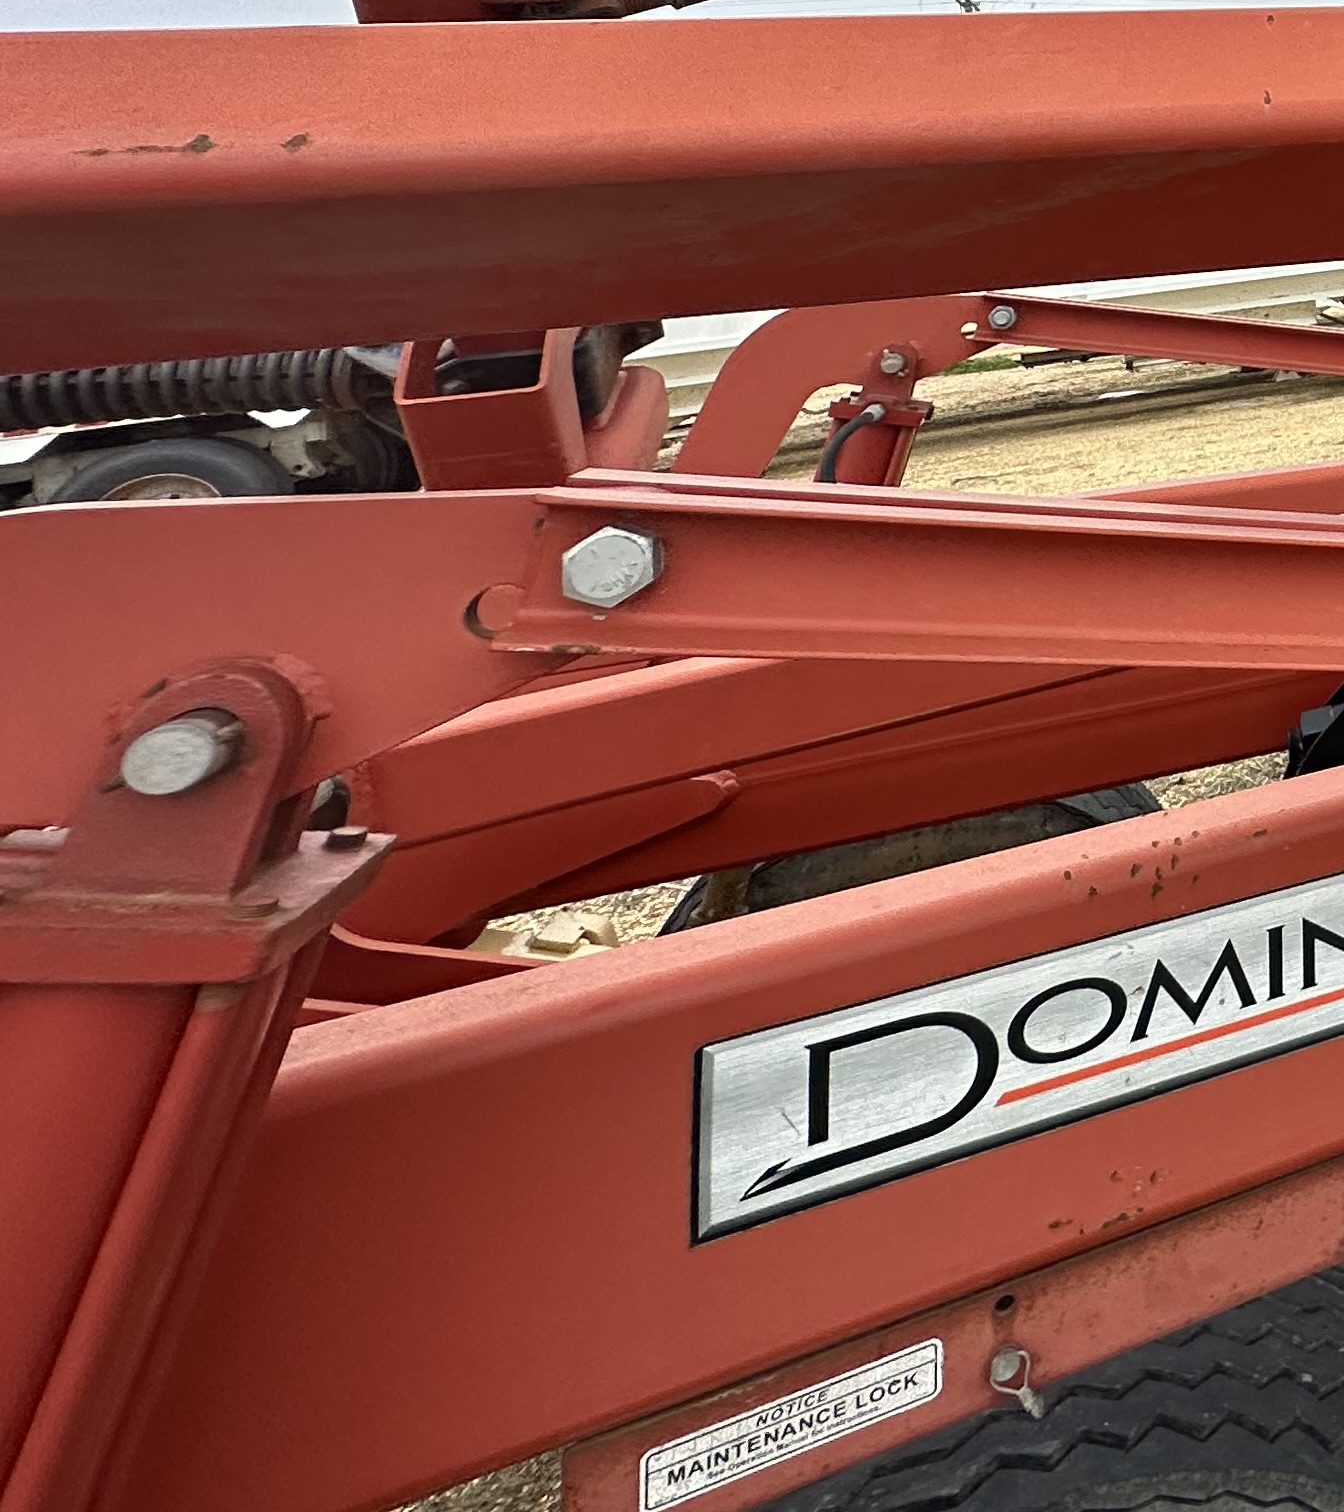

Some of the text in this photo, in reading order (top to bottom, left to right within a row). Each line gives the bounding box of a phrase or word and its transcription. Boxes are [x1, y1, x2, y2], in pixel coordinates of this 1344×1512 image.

[666, 1369, 919, 1487] MAINTENANCE LOCK
[756, 1390, 828, 1428] NOTICE
